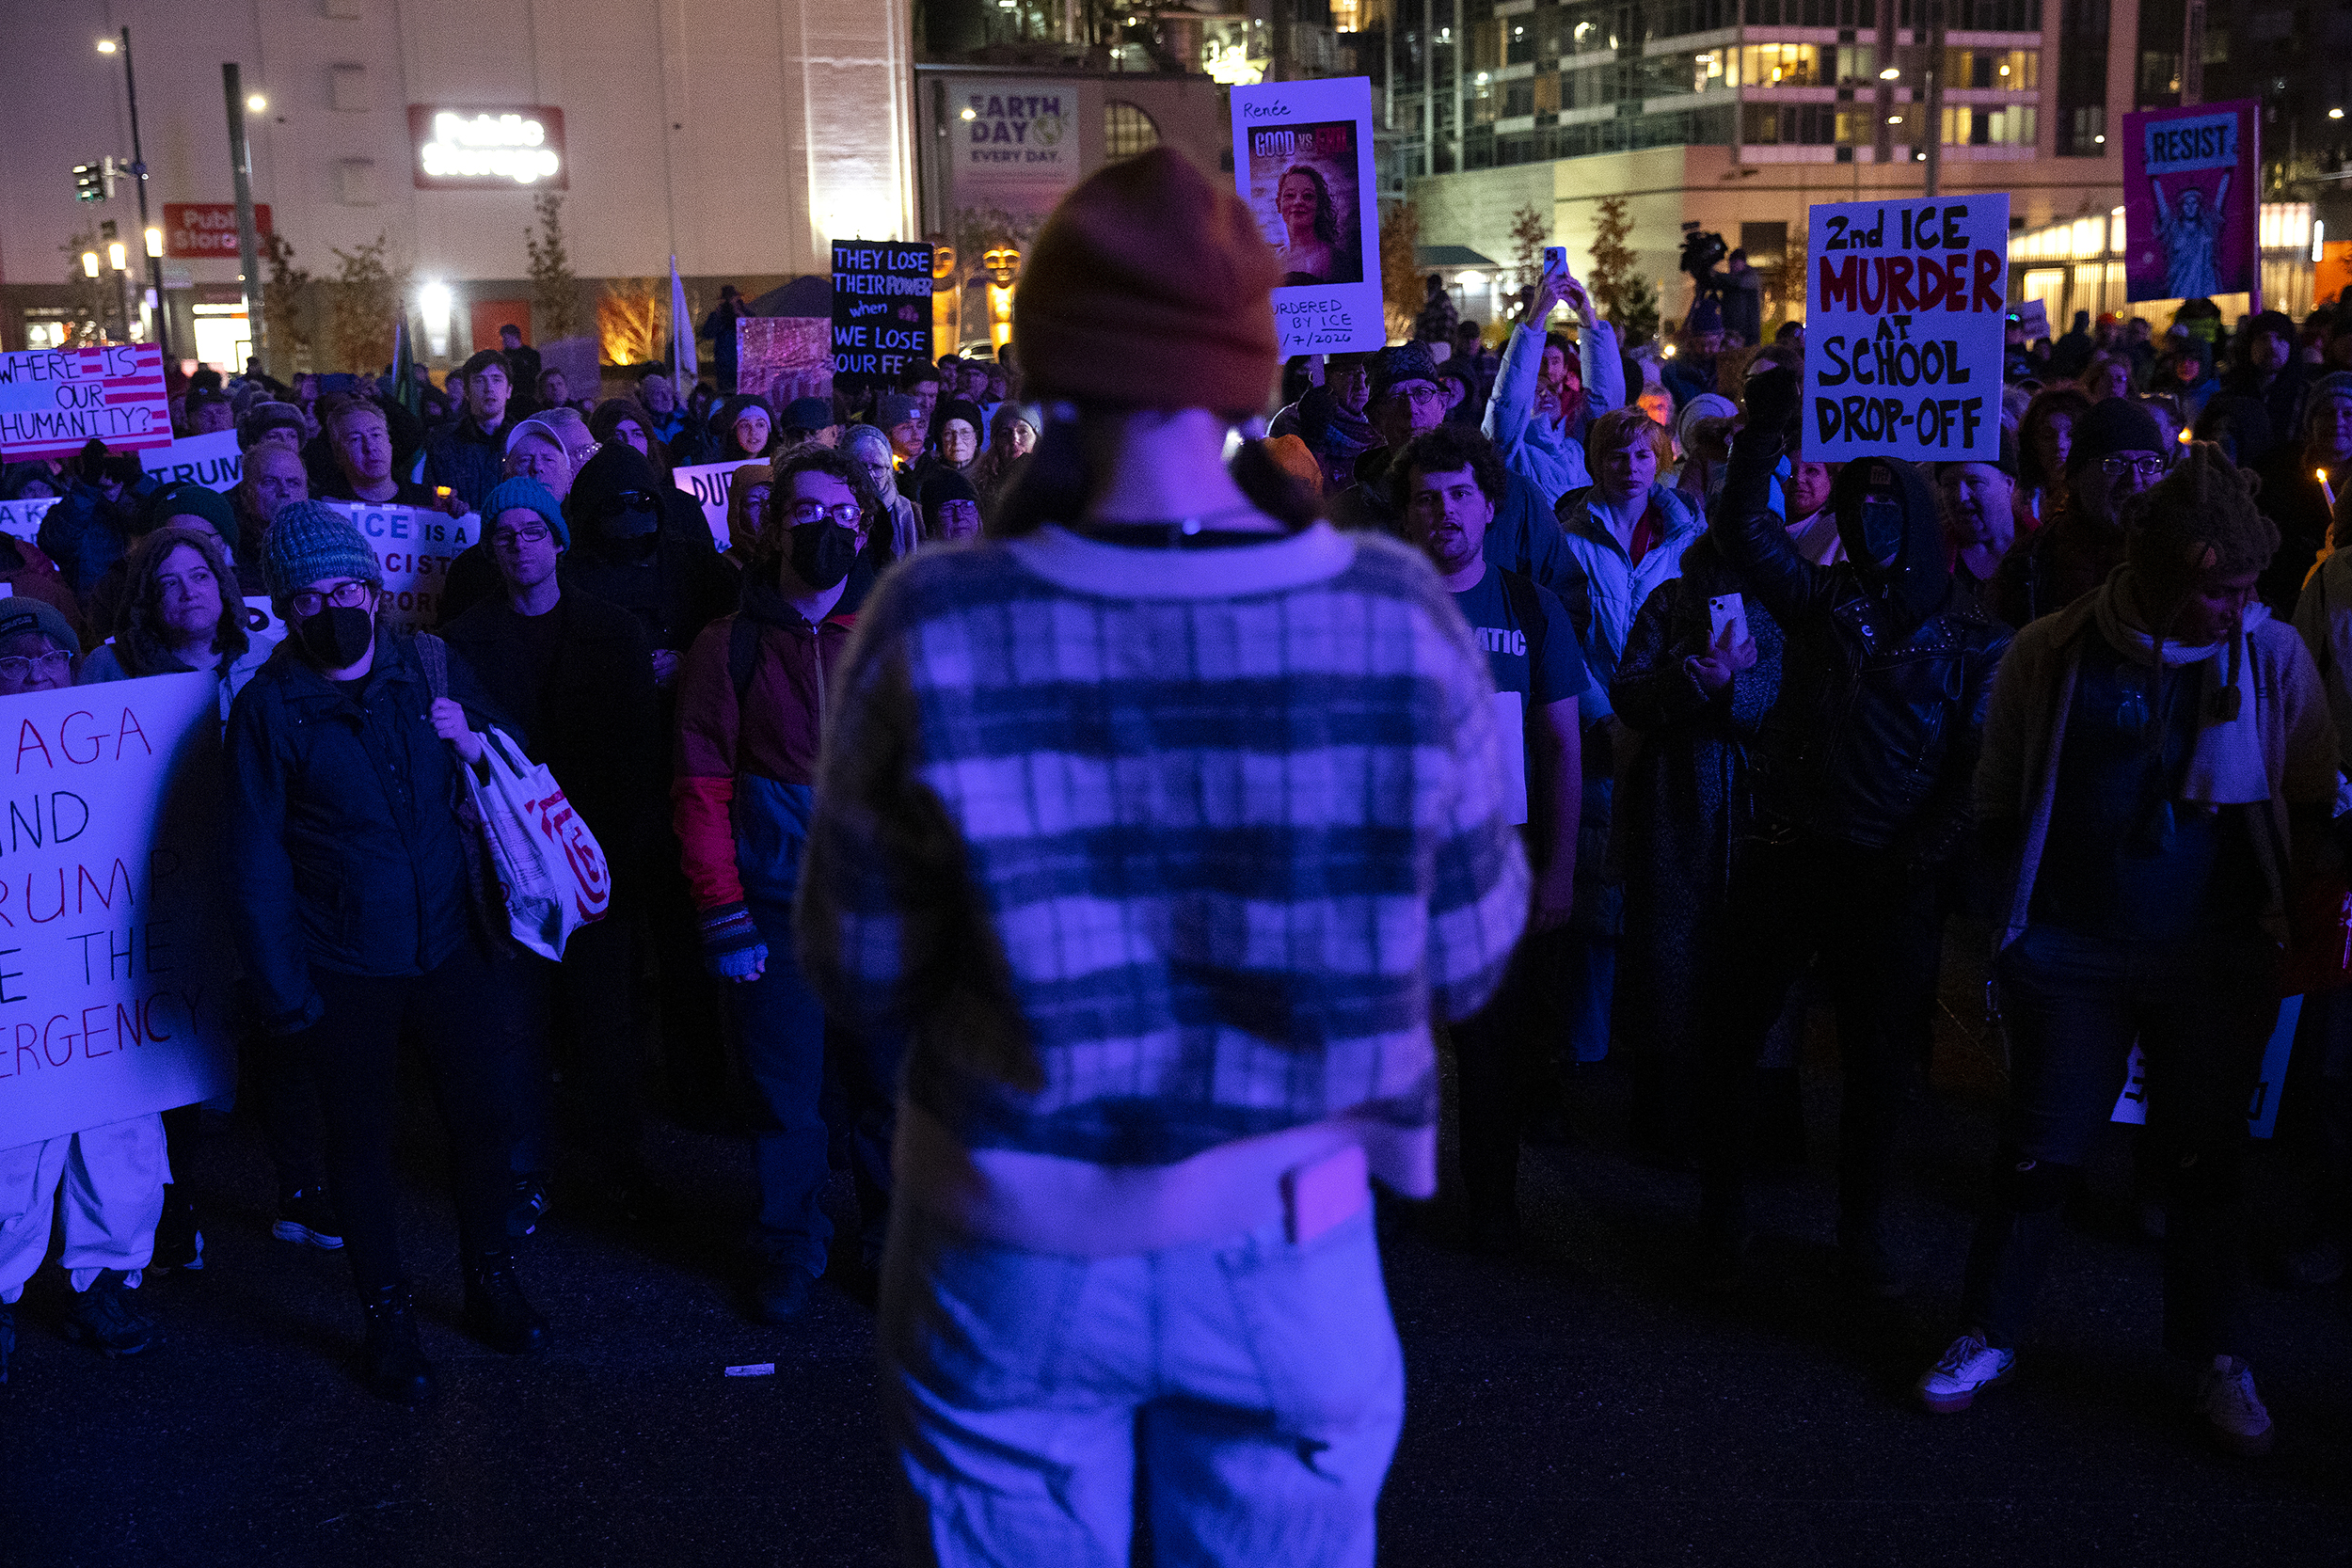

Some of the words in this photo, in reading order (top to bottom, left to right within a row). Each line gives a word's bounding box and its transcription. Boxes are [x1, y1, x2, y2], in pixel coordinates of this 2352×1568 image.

[969, 95, 1060, 119] EARTH
[1244, 101, 1292, 119] Renée
[971, 120, 1029, 144] DAY
[1255, 130, 1295, 158] GOOD
[2153, 125, 2229, 163] RESIST
[971, 150, 1021, 163] EVERY
[1825, 208, 1884, 251] 2nd
[1901, 204, 1970, 250] ICE
[834, 247, 883, 270] THEY
[887, 249, 930, 272] LOSE
[833, 273, 885, 294] THEIR
[885, 275, 933, 297] POWER
[1820, 249, 2004, 315] MURDER
[849, 300, 888, 317] when
[1292, 317, 1311, 329] BY
[1321, 313, 1352, 328] ICE
[834, 325, 867, 347] WE
[875, 326, 926, 351] LOSE
[1875, 314, 1912, 341] AT
[0, 351, 81, 385] WHERE
[102, 347, 137, 377] IS
[835, 353, 877, 374] OUR
[882, 354, 926, 374] FE
[1817, 336, 1971, 387] SCHOOL
[56, 384, 104, 410] OUR
[0, 406, 152, 442] HUMANITY?
[1815, 395, 1982, 449] DROP-OFF
[424, 523, 446, 543] IS
[453, 527, 469, 545] A
[0, 790, 89, 858] ND
